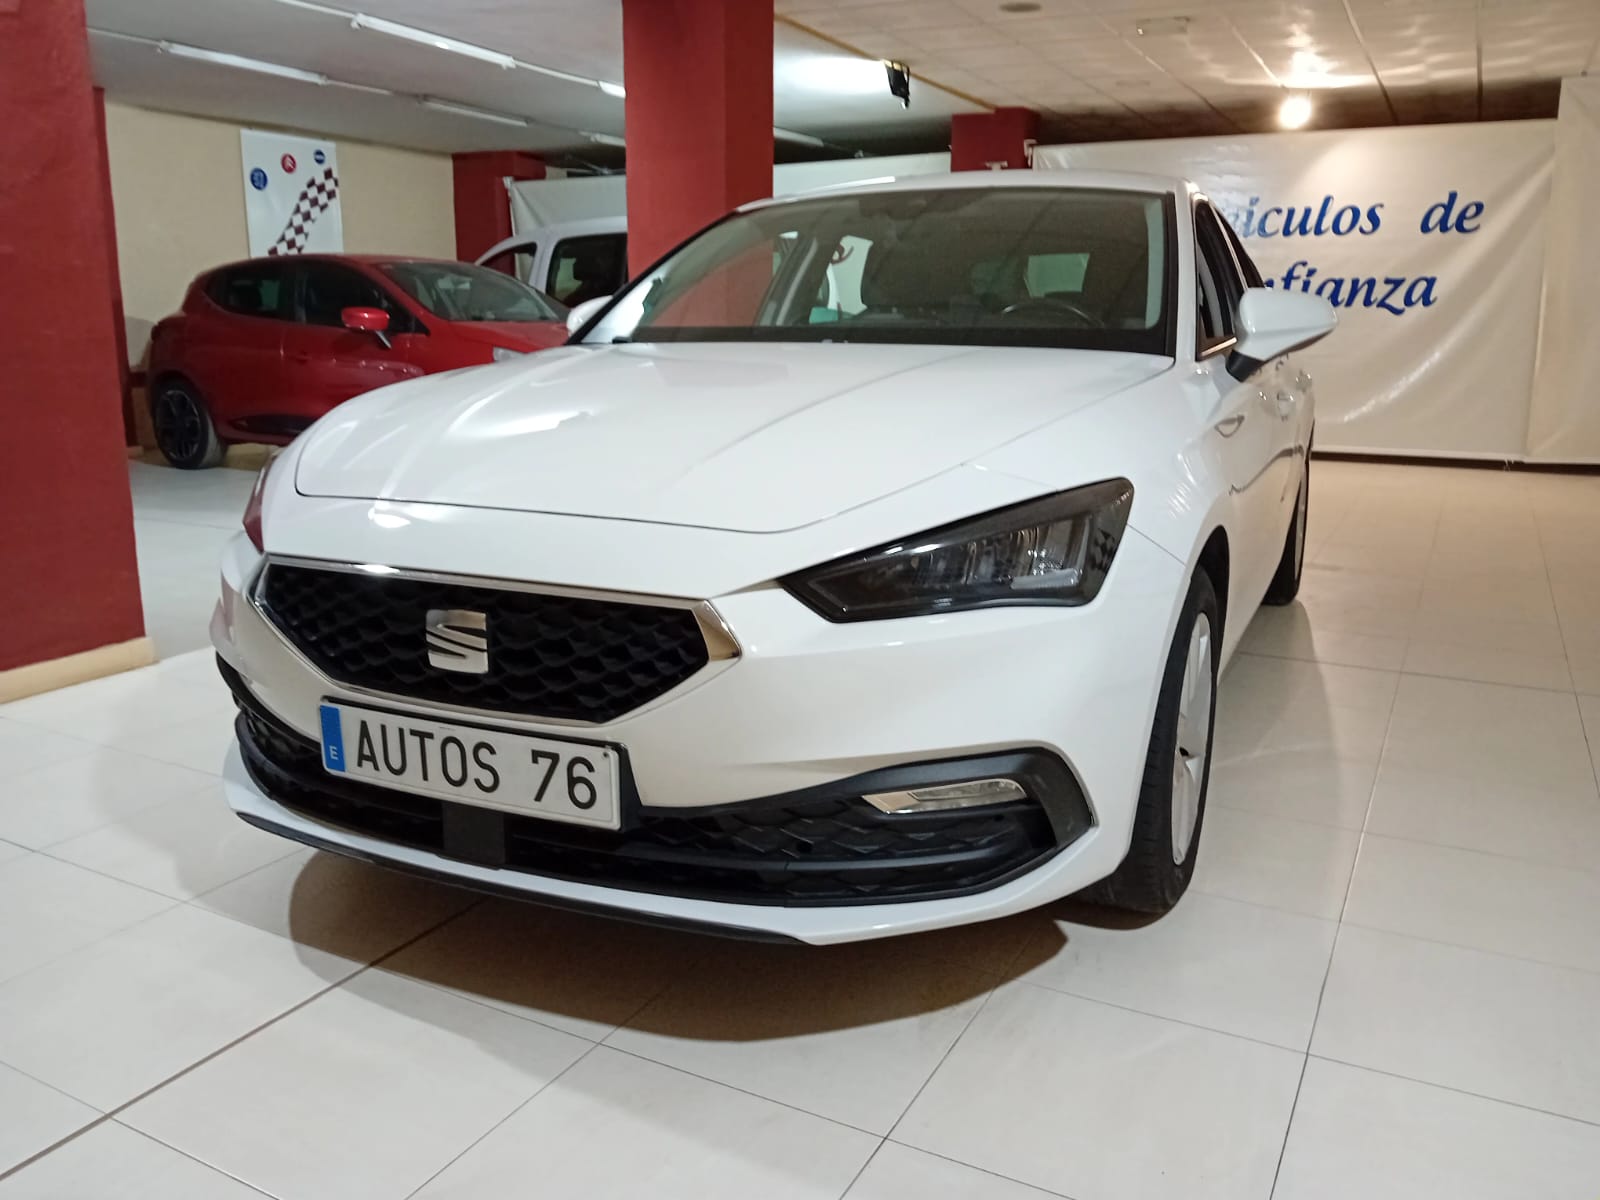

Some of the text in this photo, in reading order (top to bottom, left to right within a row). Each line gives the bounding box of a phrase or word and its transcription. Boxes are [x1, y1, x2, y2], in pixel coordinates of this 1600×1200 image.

[1420, 191, 1484, 234] de
[1264, 261, 1437, 315] fianza
[329, 745, 339, 760] E
[357, 720, 597, 810] AUTOS 76
